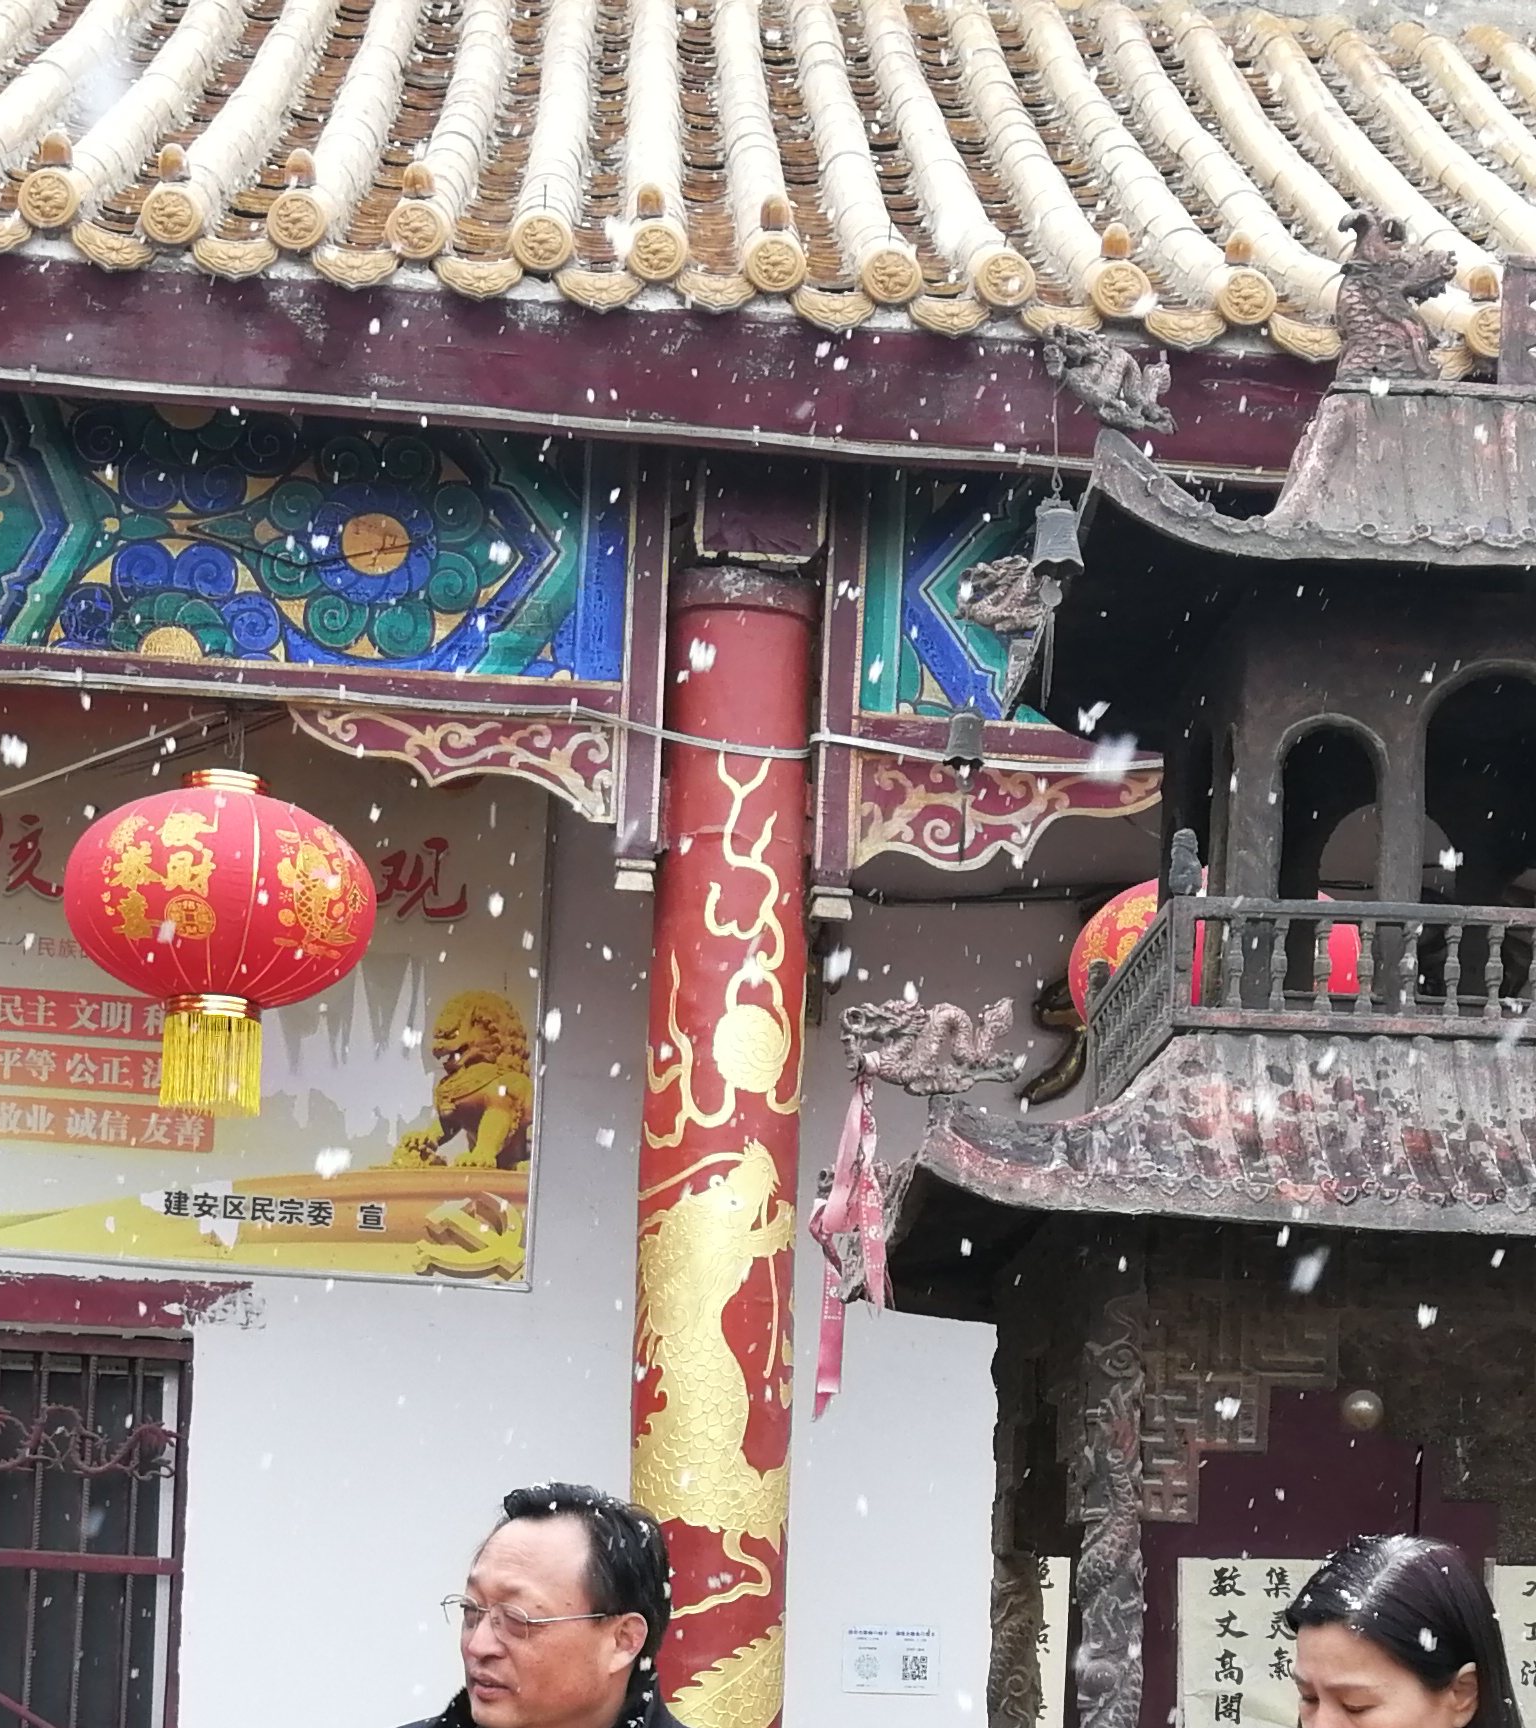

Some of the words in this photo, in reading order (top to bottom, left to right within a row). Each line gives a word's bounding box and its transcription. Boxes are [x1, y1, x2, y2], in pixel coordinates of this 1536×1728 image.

[67, 998, 134, 1036] 文明
[65, 1052, 132, 1086] 公正
[65, 1107, 131, 1142] 诚信
[140, 1112, 206, 1148] 友善
[164, 1190, 334, 1227] 建安区民宗委
[358, 1203, 386, 1231] 宣
